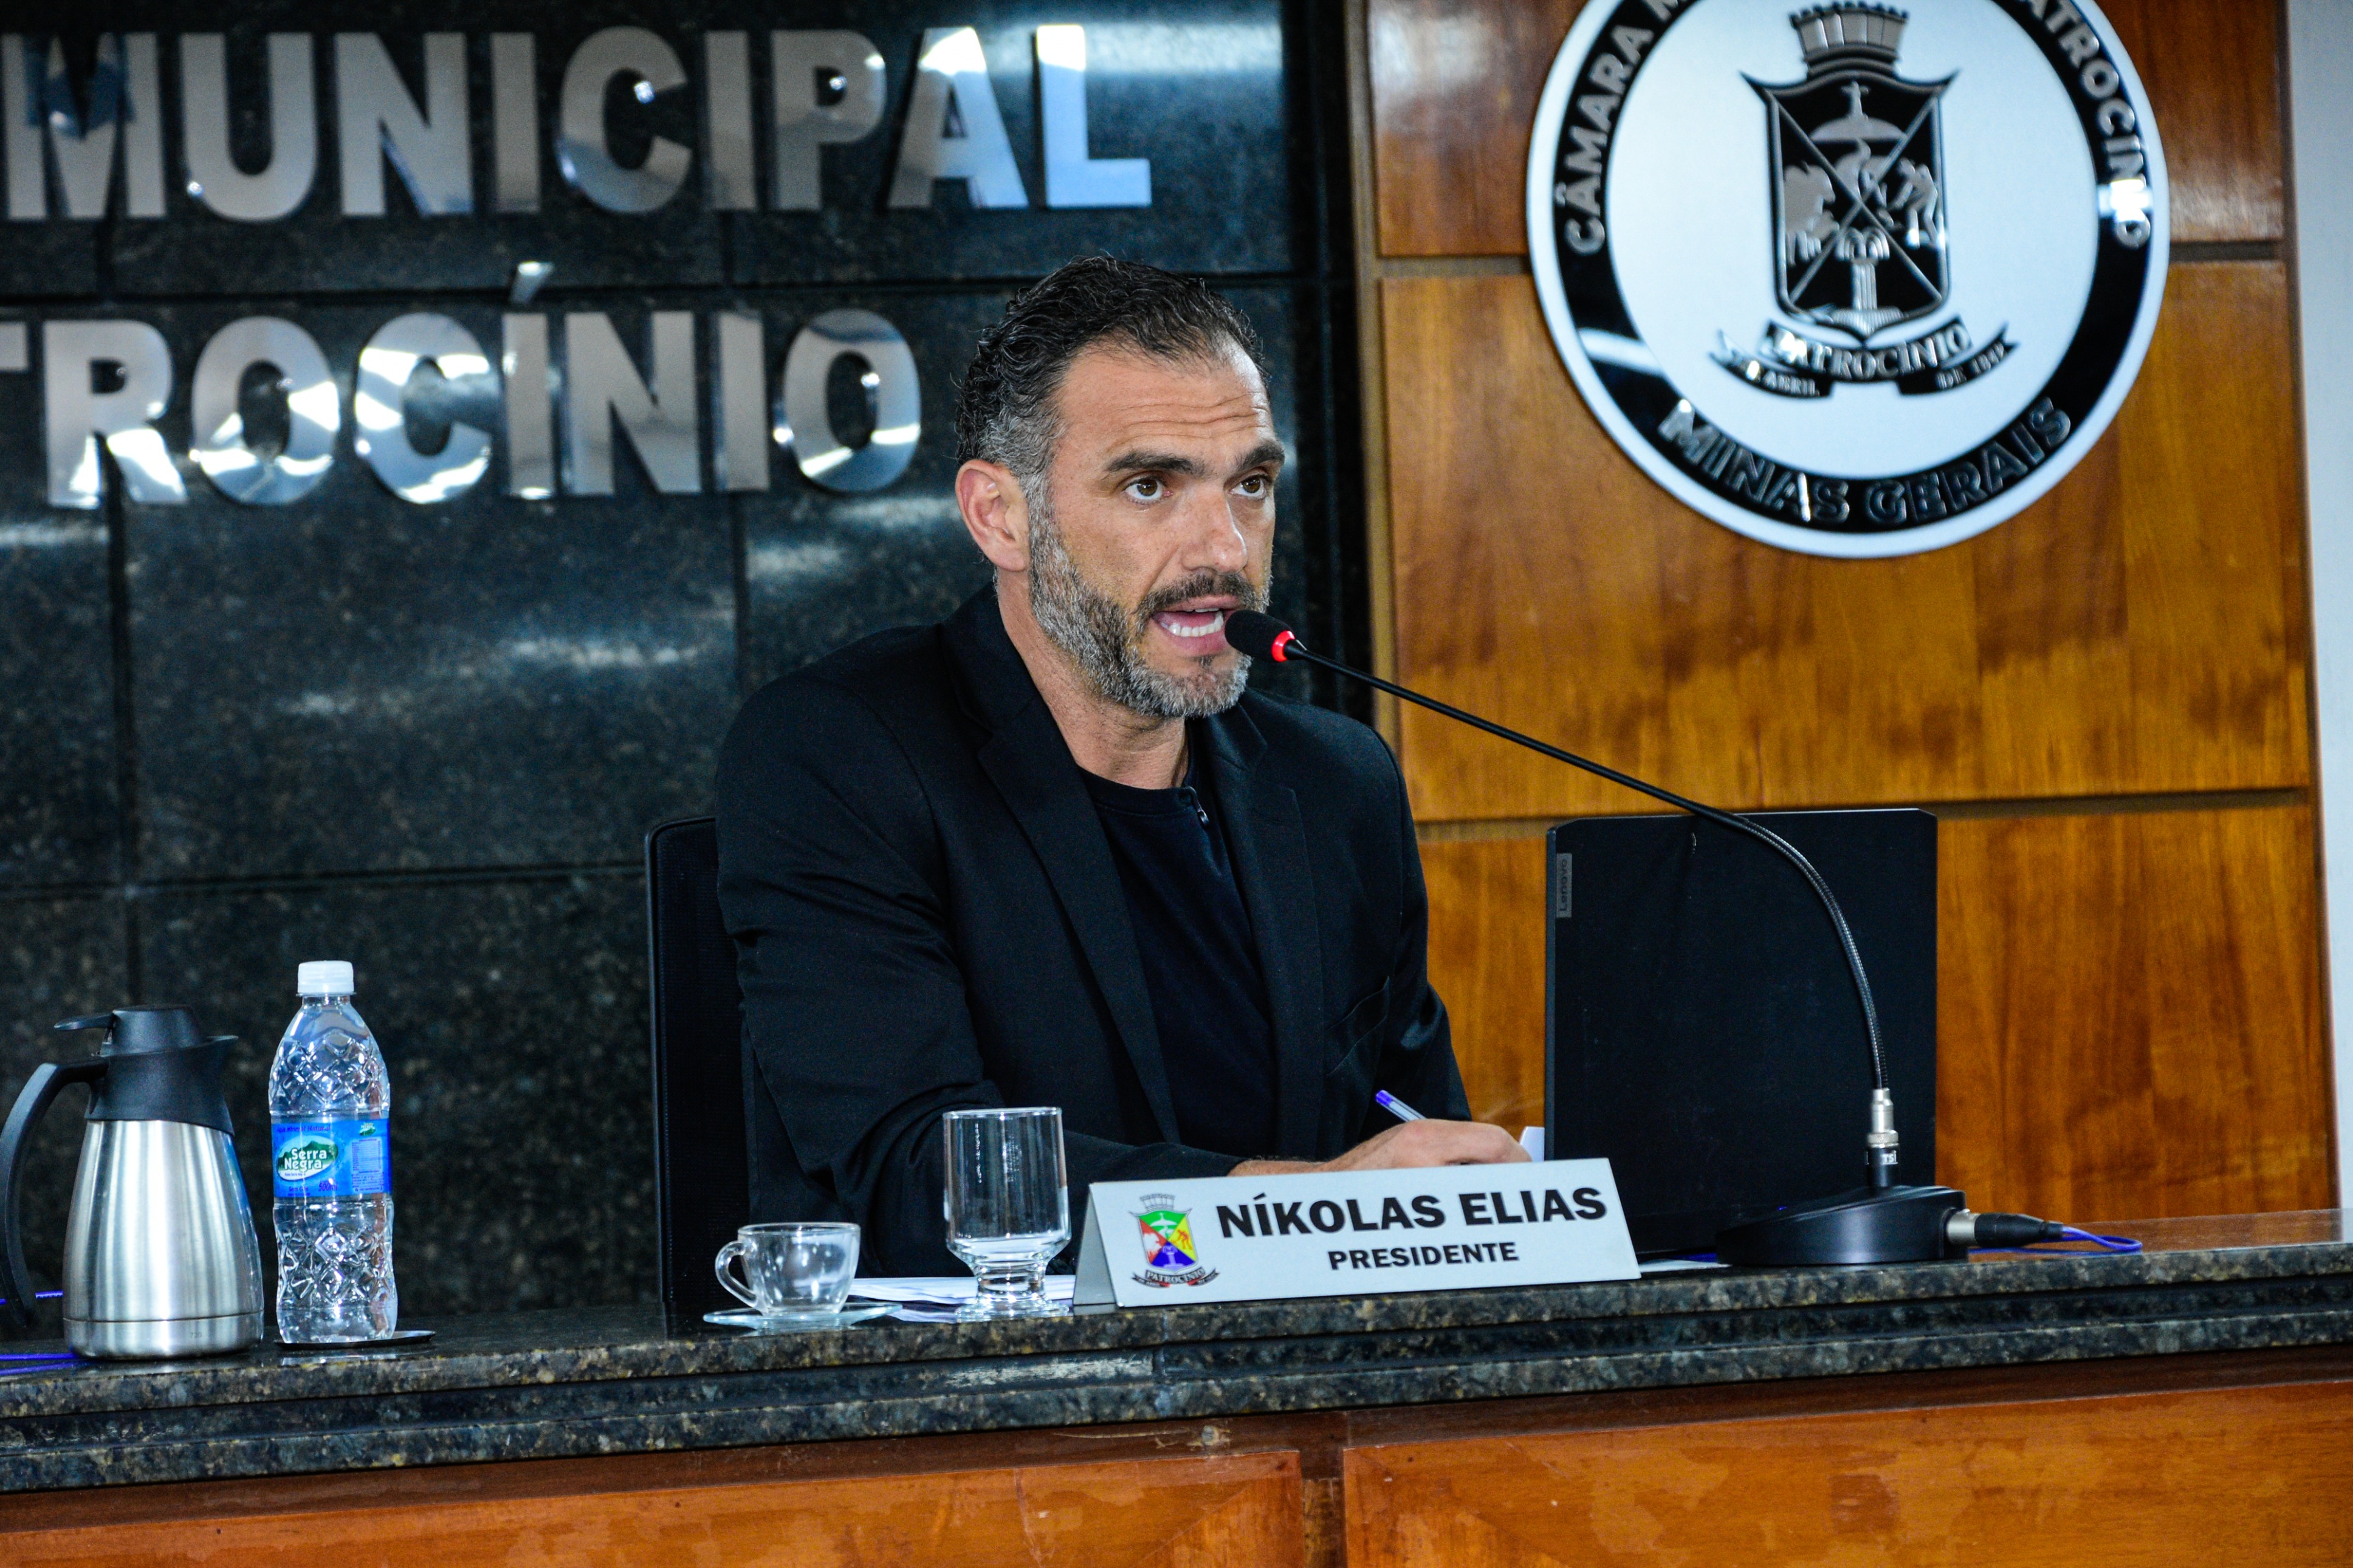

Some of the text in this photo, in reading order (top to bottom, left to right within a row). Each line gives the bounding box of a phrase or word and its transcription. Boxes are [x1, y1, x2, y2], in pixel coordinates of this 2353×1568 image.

[2, 23, 1152, 221] MUNICIPAL
[1554, 24, 1654, 255] CÂMARA
[0, 260, 922, 507] ROCÍNIO
[1658, 396, 2070, 525] MINAS GERAIS
[1559, 858, 1567, 911] Lenovo
[284, 1157, 323, 1172] Negra
[291, 1148, 328, 1160] Serra
[1217, 1187, 1607, 1238] NÍKOLAS ELIAS
[1327, 1242, 1519, 1270] PRESIDENTE
